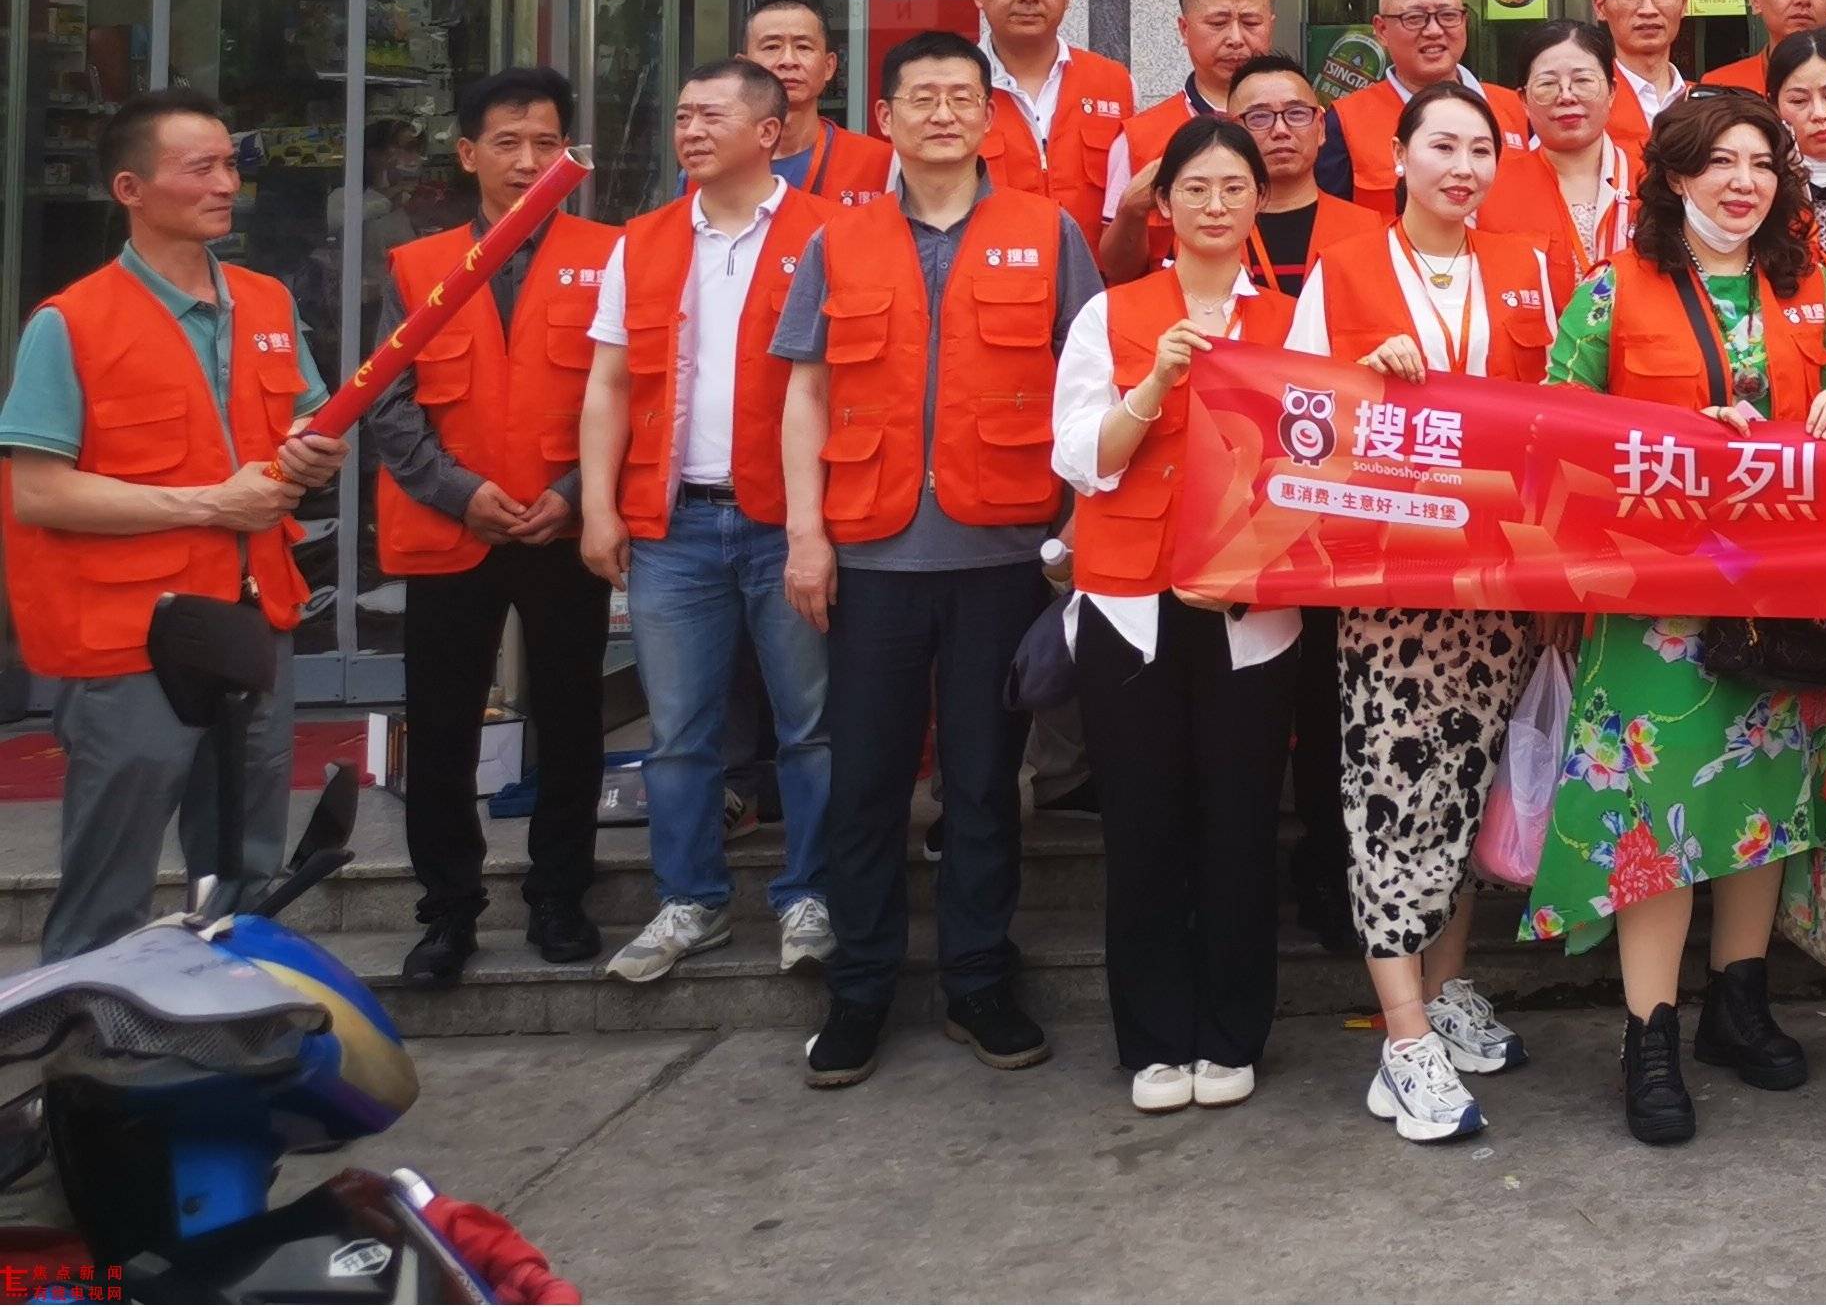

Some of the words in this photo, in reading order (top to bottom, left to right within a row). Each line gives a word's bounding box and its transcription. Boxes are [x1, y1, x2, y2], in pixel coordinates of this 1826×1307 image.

[1323, 60, 1376, 91] TSINGTA
[1007, 248, 1038, 263] 搜堡
[1351, 399, 1463, 468] 搜堡
[1351, 459, 1462, 486] soubaoshop.com
